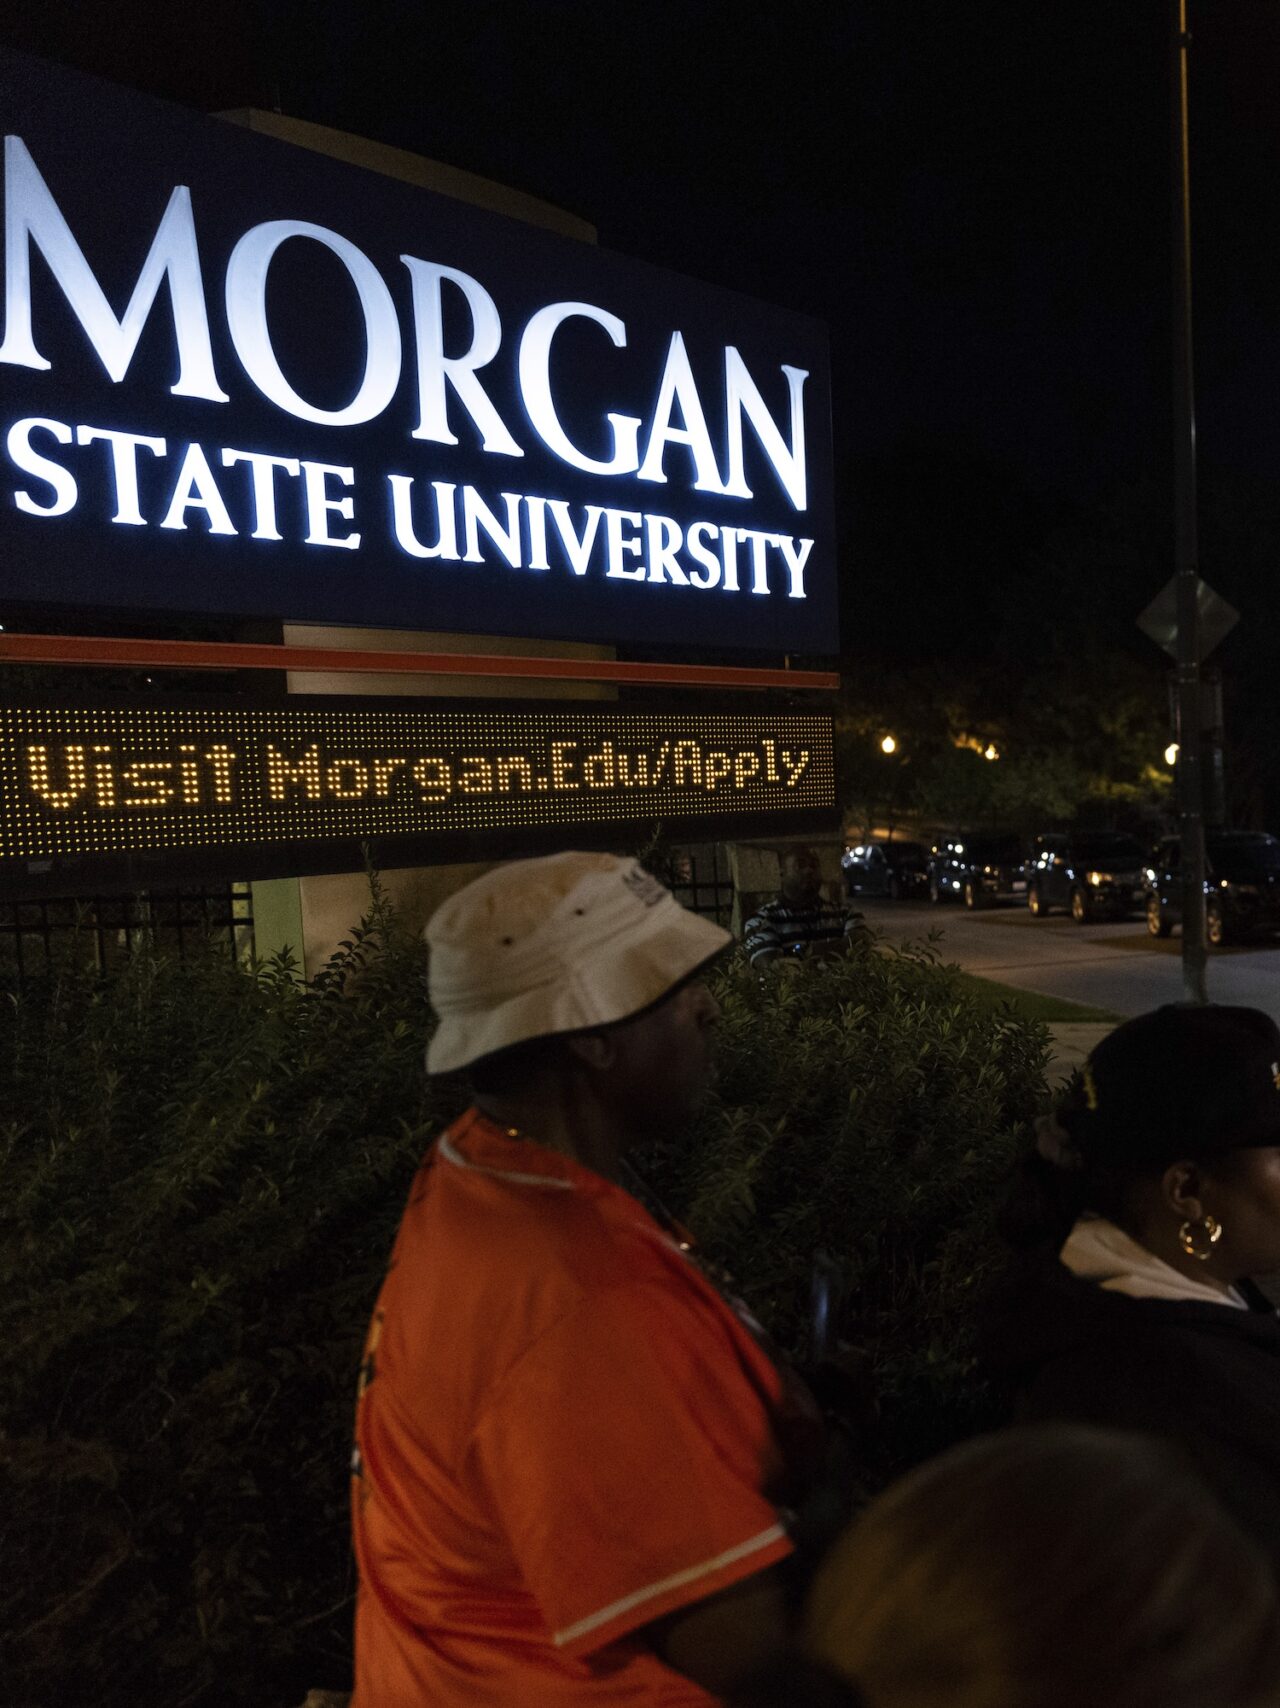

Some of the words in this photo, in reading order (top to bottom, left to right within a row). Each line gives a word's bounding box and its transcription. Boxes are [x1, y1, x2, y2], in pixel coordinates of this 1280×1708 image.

[0, 135, 809, 511] MORGAN
[3, 417, 361, 550] STATE
[386, 474, 814, 598] UNIVERSITY
[27, 745, 238, 809] Visit
[266, 738, 809, 800] Morgan.Edu/Apply
